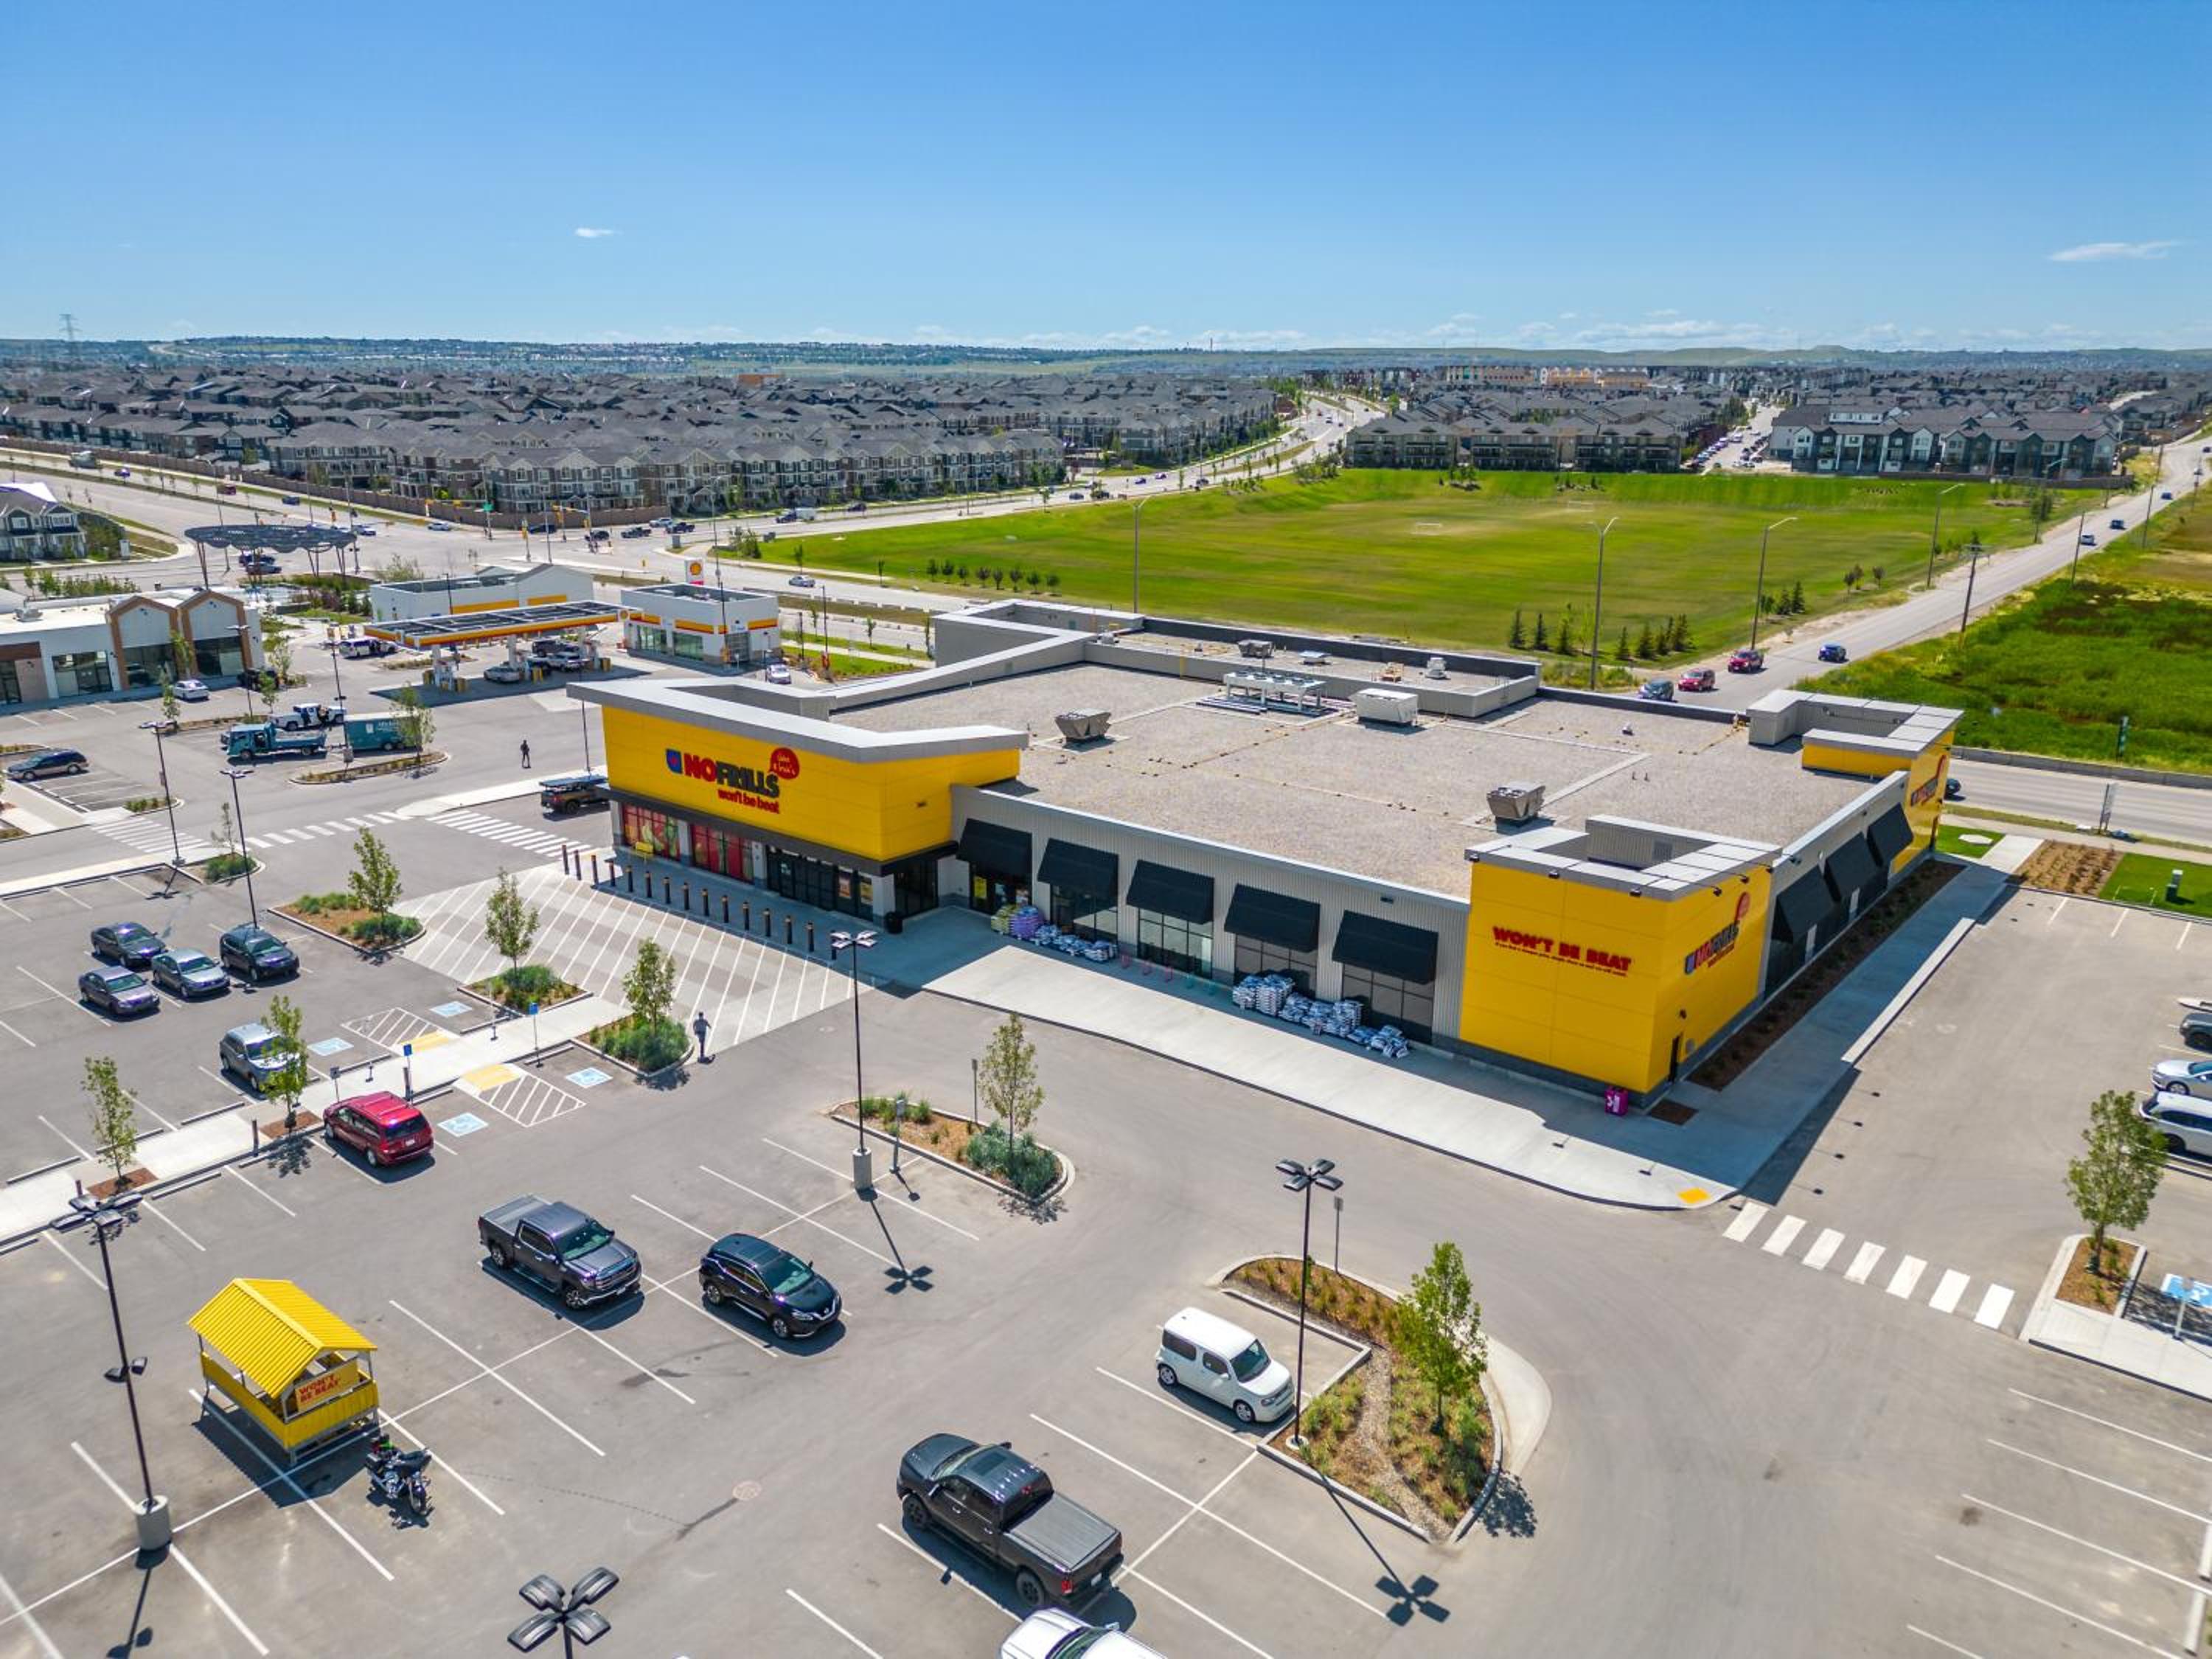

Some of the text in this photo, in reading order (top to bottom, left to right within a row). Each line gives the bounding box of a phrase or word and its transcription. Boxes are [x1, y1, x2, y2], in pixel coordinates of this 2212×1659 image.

[717, 788, 780, 814] won't be beat
[1492, 925, 1554, 953] WON'T
[1558, 942, 1580, 960] BE
[1586, 948, 1631, 971] BEAT
